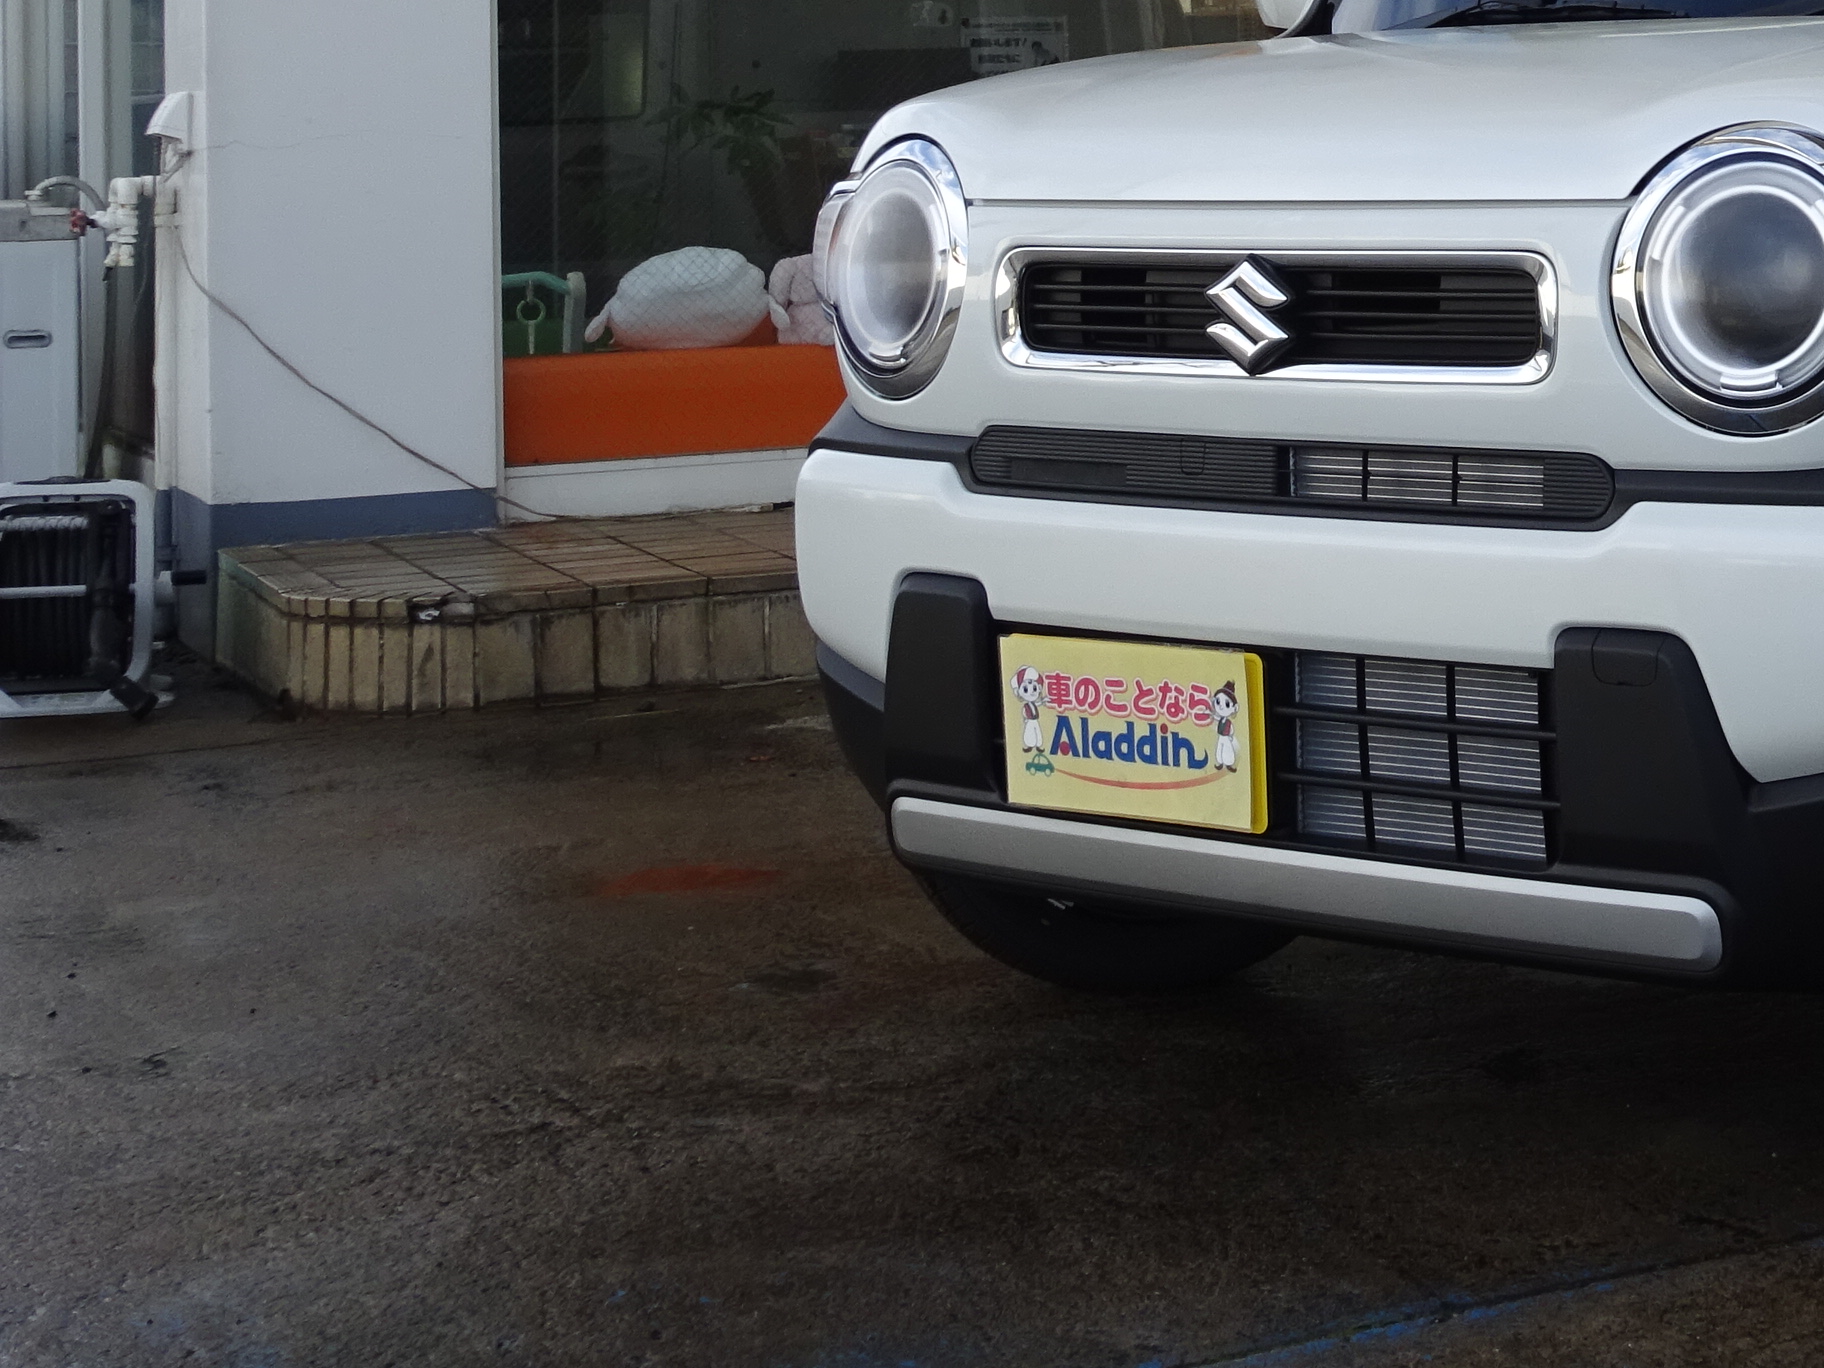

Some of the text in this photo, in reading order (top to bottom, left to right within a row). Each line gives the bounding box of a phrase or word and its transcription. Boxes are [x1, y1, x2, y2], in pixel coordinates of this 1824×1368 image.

[1043, 671, 1214, 725] 車のことなら
[1050, 715, 1209, 770] Aladdin
